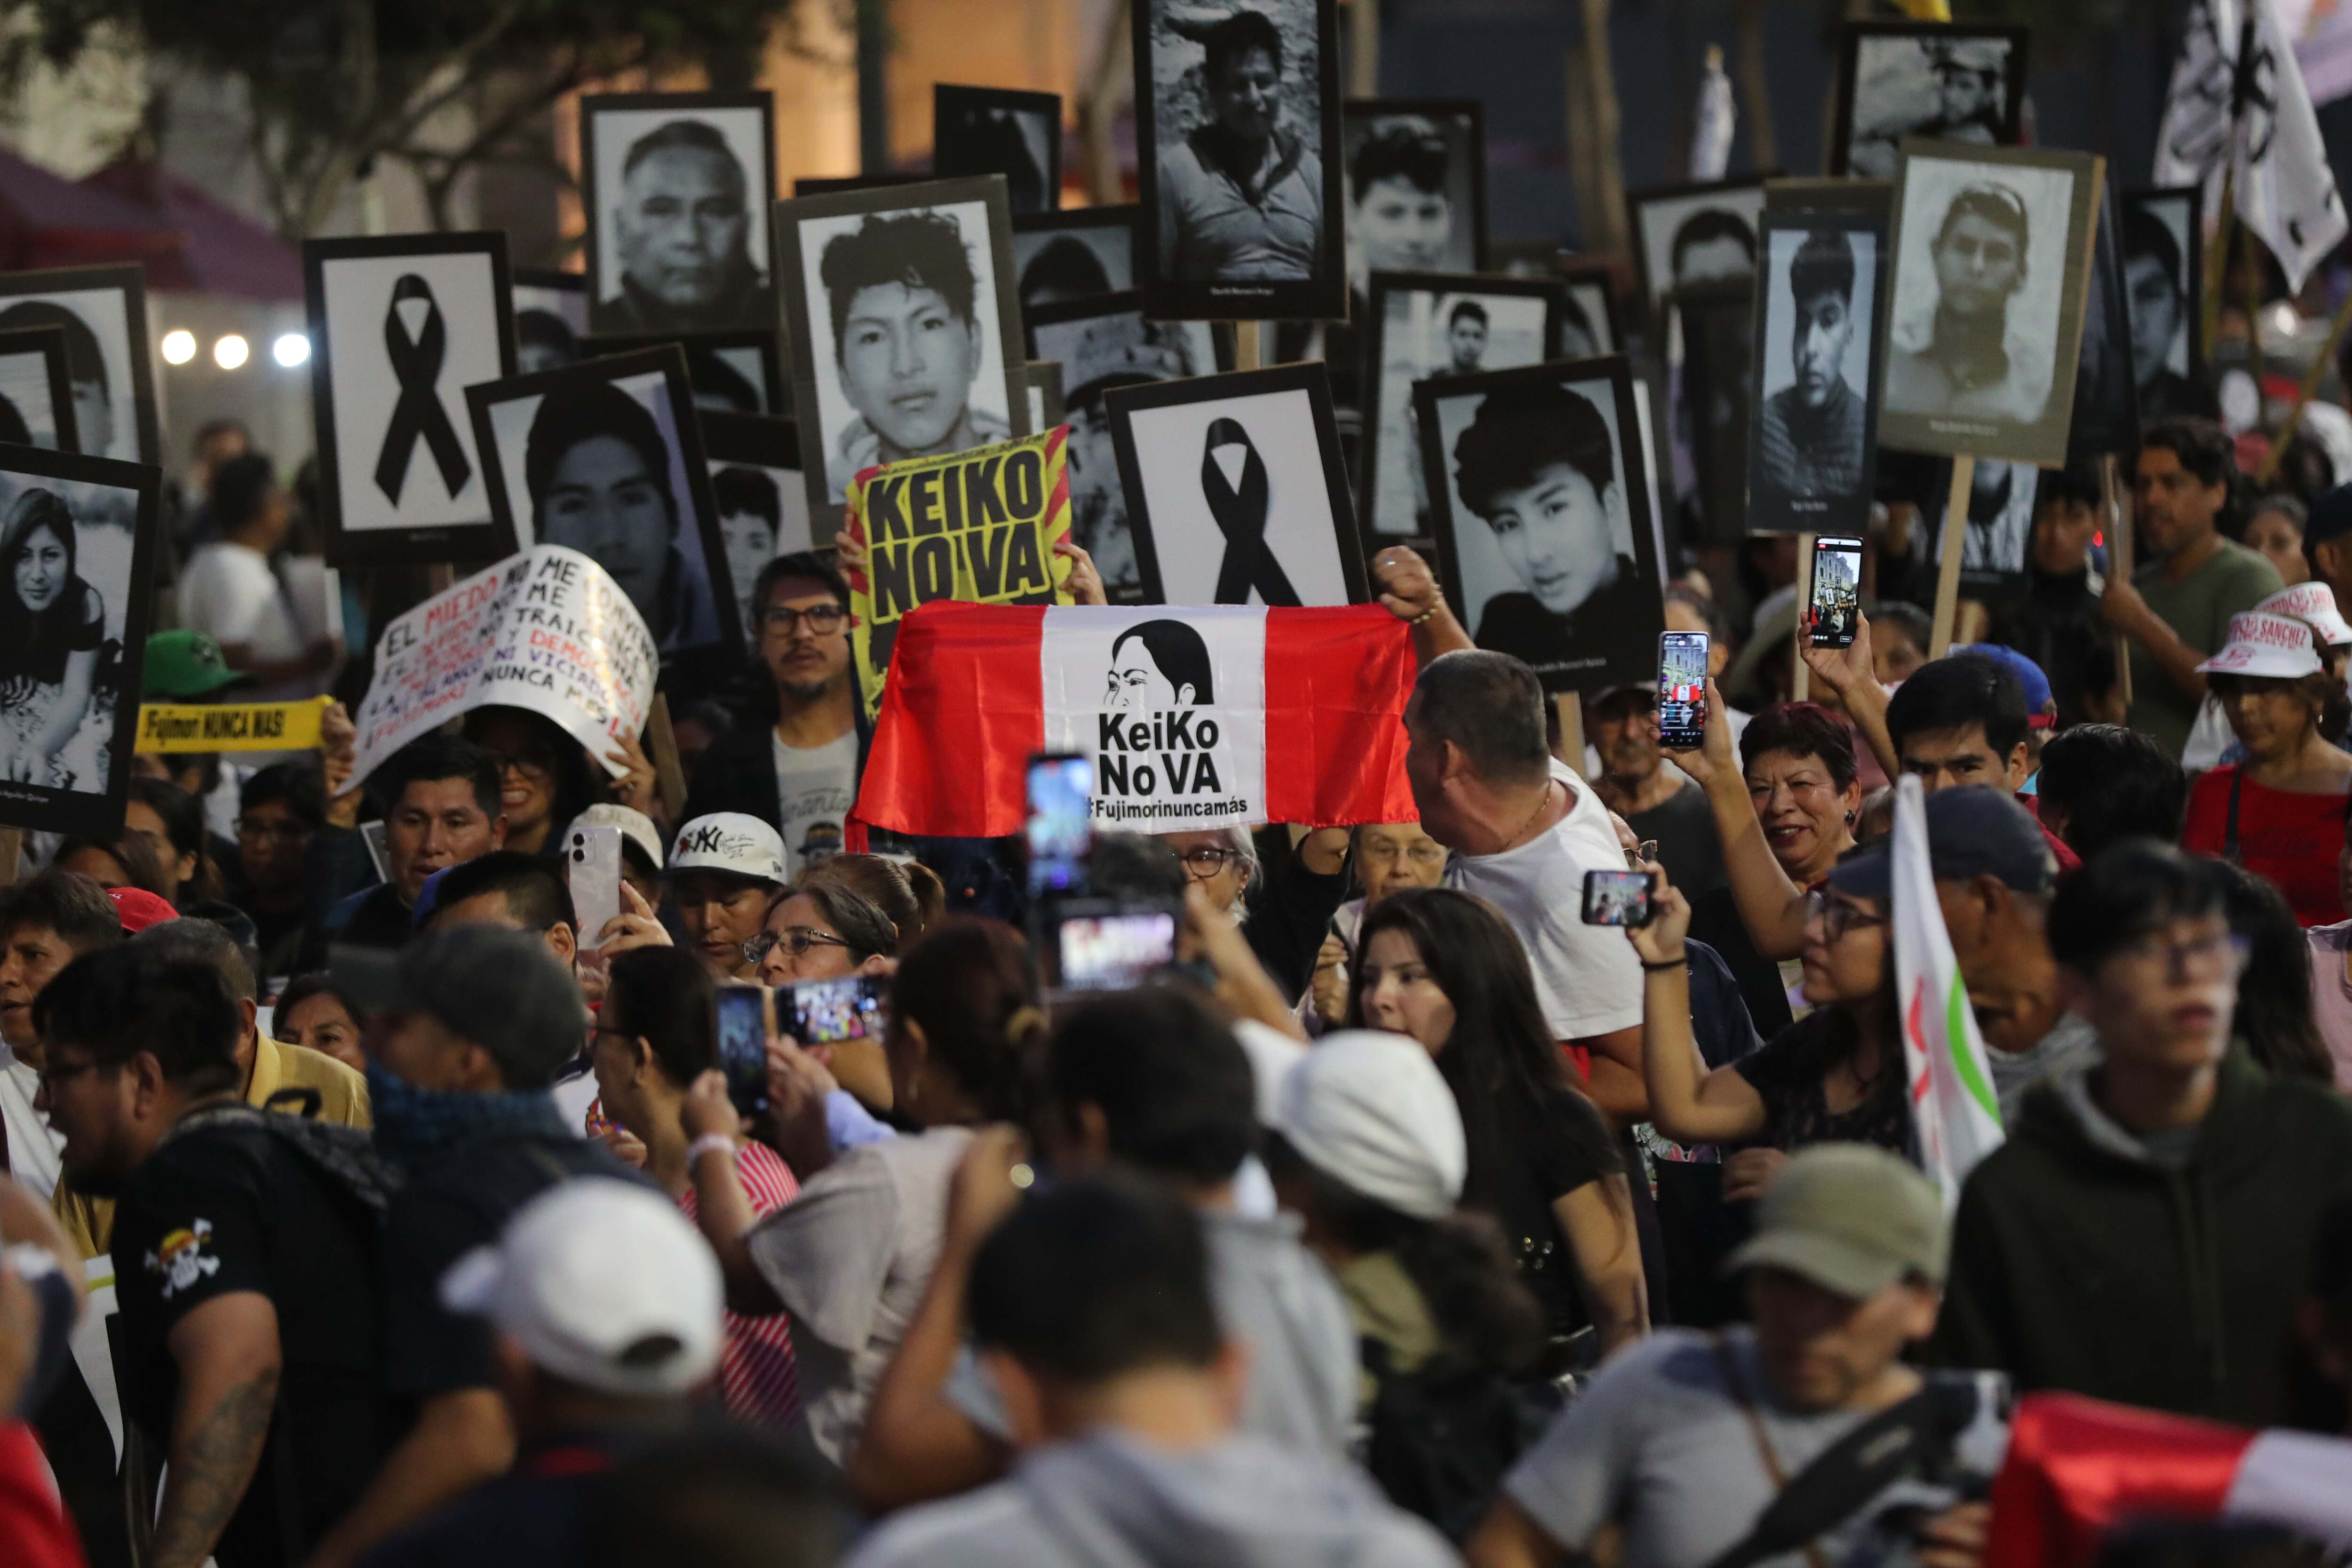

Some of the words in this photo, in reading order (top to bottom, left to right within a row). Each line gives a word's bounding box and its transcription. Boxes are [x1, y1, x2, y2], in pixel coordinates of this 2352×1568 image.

[868, 450, 1041, 543] KEIKO
[872, 536, 953, 618] NO
[966, 521, 1045, 599] VA
[387, 622, 418, 657] EL
[538, 556, 580, 586] ME
[526, 583, 567, 608] ME
[515, 607, 634, 687] TRAICNA
[478, 664, 554, 691] NUNCA
[1099, 710, 1219, 751] KeiKo
[1099, 754, 1156, 796] No
[1162, 752, 1222, 795] VA
[1084, 796, 1248, 822] #Fujimorinuncamás
